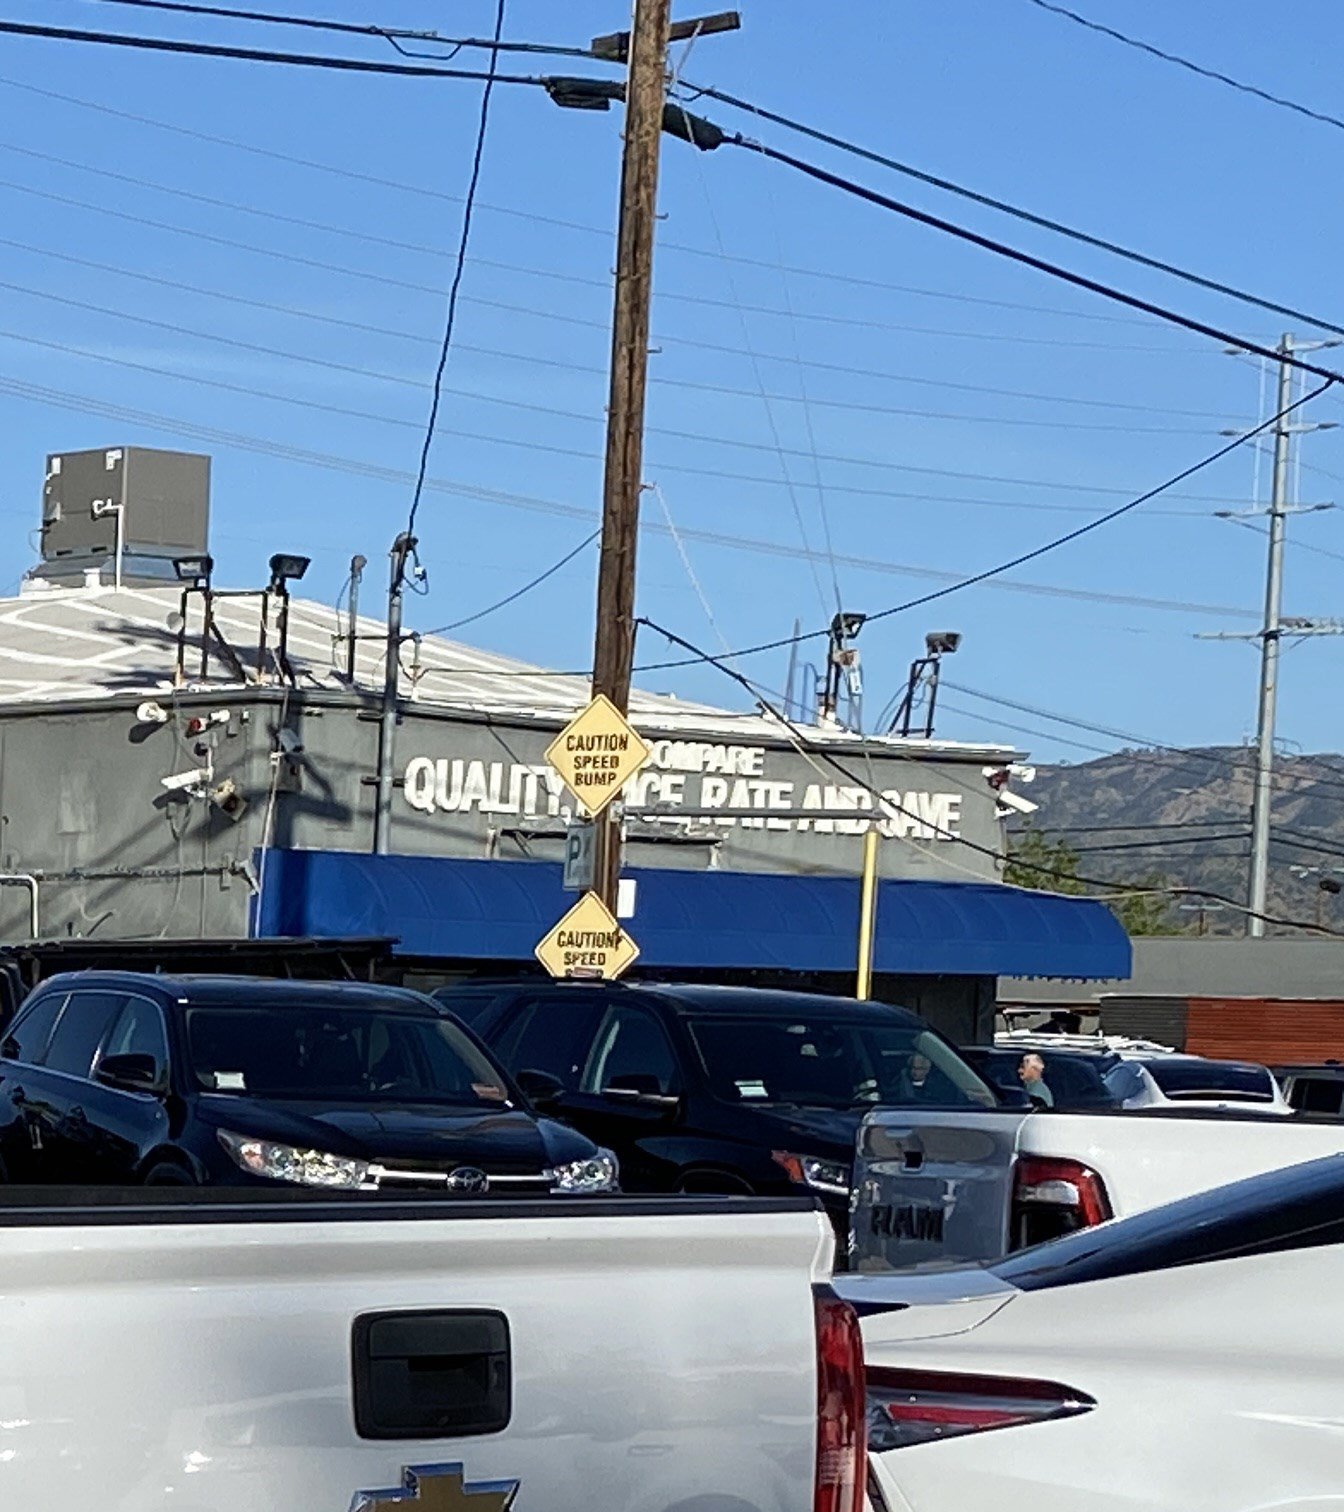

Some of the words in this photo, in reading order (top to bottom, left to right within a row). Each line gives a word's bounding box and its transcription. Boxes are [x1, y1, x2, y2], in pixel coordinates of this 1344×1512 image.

[566, 733, 629, 752] CAUTION
[573, 755, 620, 769] SPEED
[573, 772, 617, 787] BUMP
[700, 777, 795, 833] RATE
[797, 784, 873, 835] AND
[877, 790, 963, 841] SAVE
[557, 930, 618, 950] CAUTION
[564, 952, 606, 967] SPEED
